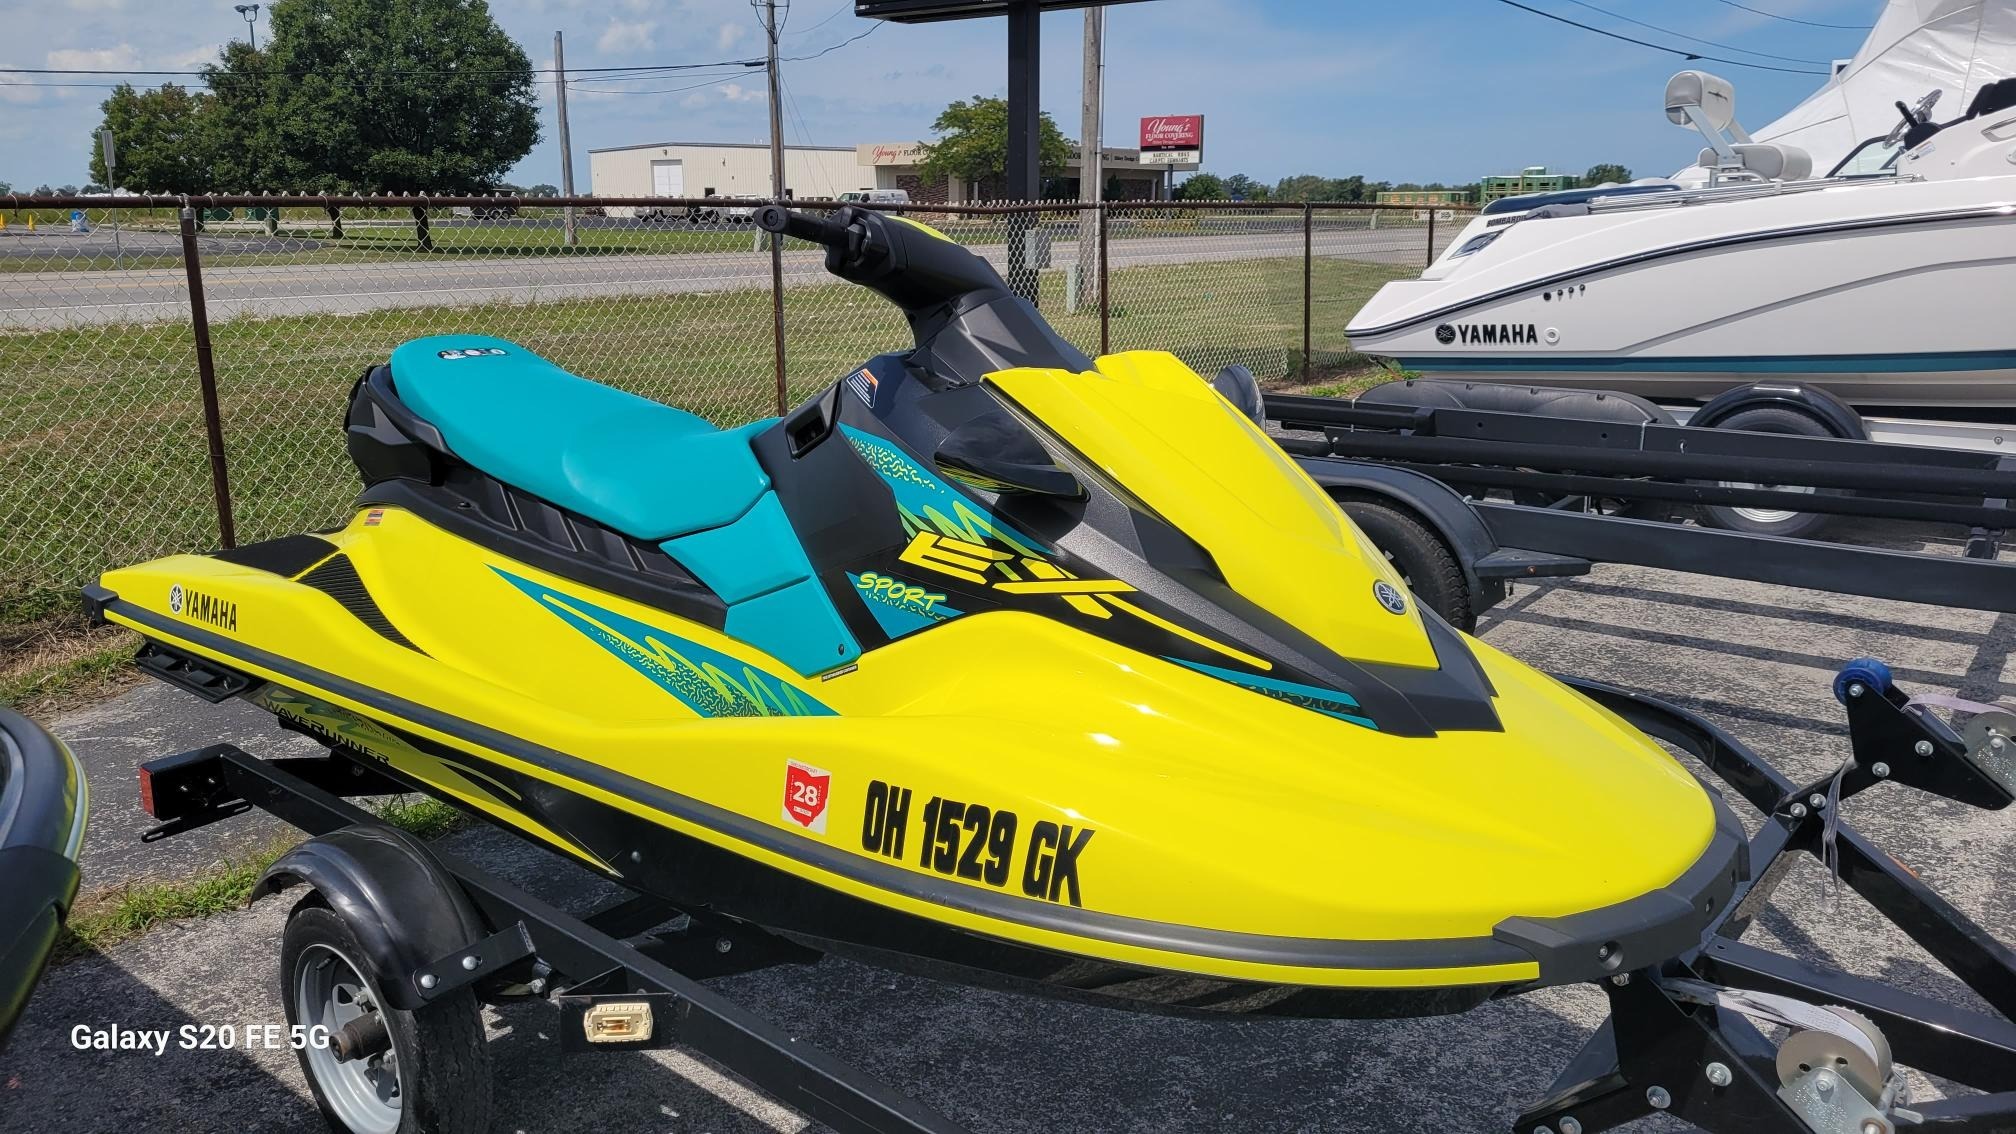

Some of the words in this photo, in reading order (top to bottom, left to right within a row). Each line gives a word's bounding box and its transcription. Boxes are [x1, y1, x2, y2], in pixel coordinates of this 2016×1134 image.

[1147, 118, 1191, 142] Young's
[872, 145, 902, 165] Young's
[1458, 324, 1538, 343] YAMAHA
[856, 572, 947, 611] SPORT
[185, 588, 237, 633] YAMAHA
[792, 781, 818, 807] 28
[861, 780, 912, 861] OH
[919, 795, 1018, 888] 1529
[1022, 819, 1096, 908] GK
